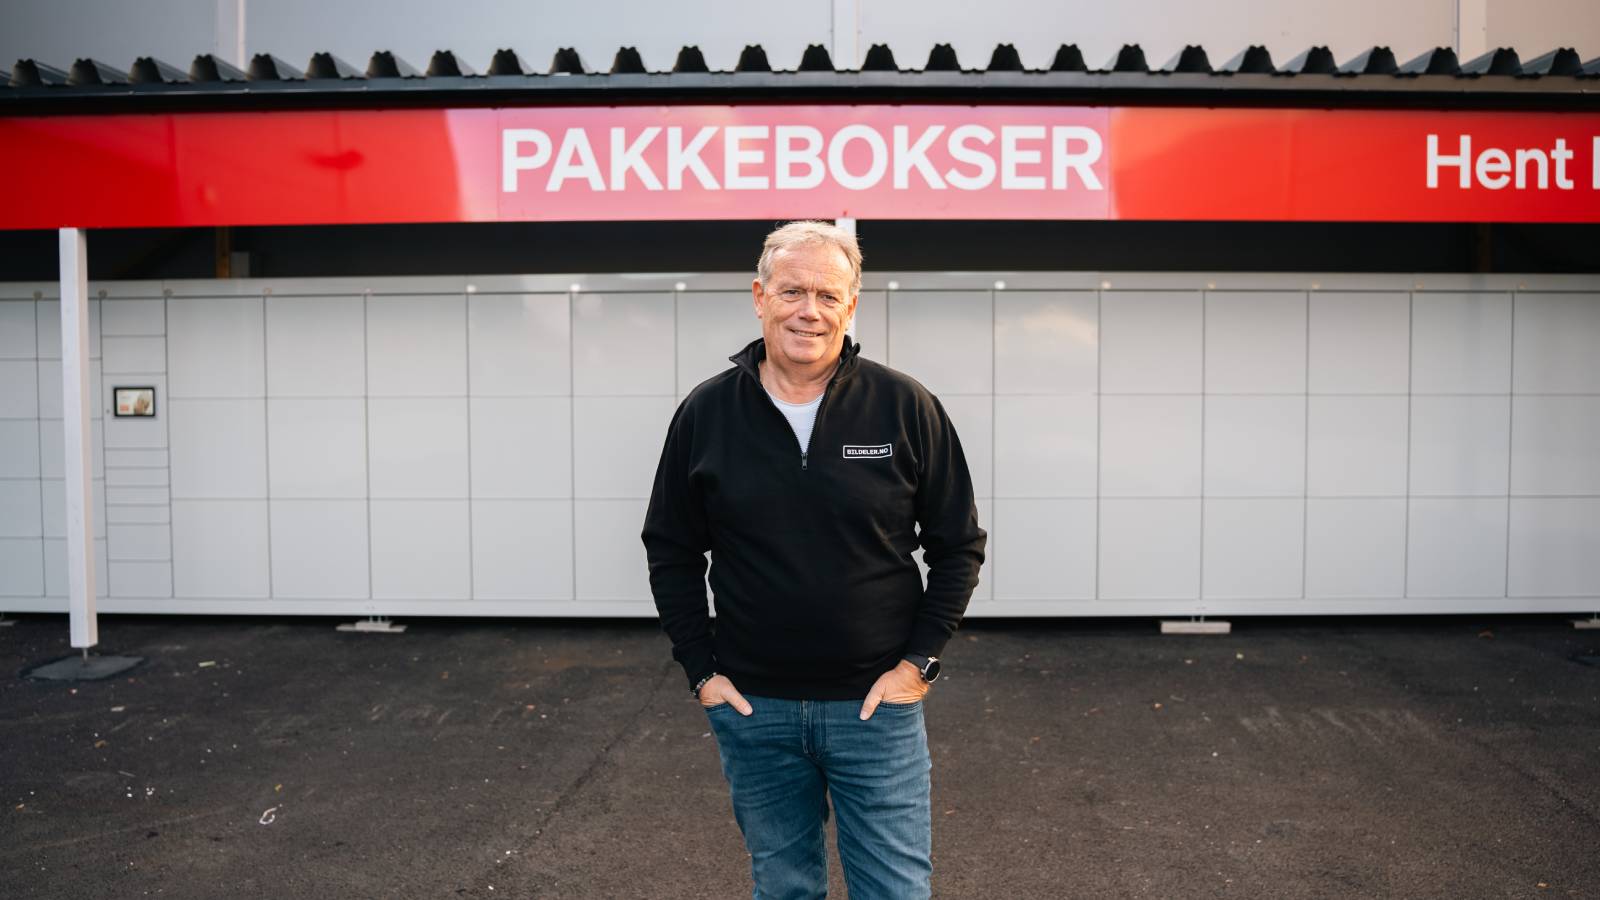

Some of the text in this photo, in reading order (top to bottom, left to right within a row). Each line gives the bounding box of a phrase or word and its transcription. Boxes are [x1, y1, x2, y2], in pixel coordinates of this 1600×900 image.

[501, 124, 1104, 193] PAKKEBOKSER
[1426, 134, 1575, 190] Hent
[846, 447, 889, 455] BILDELER.NO
